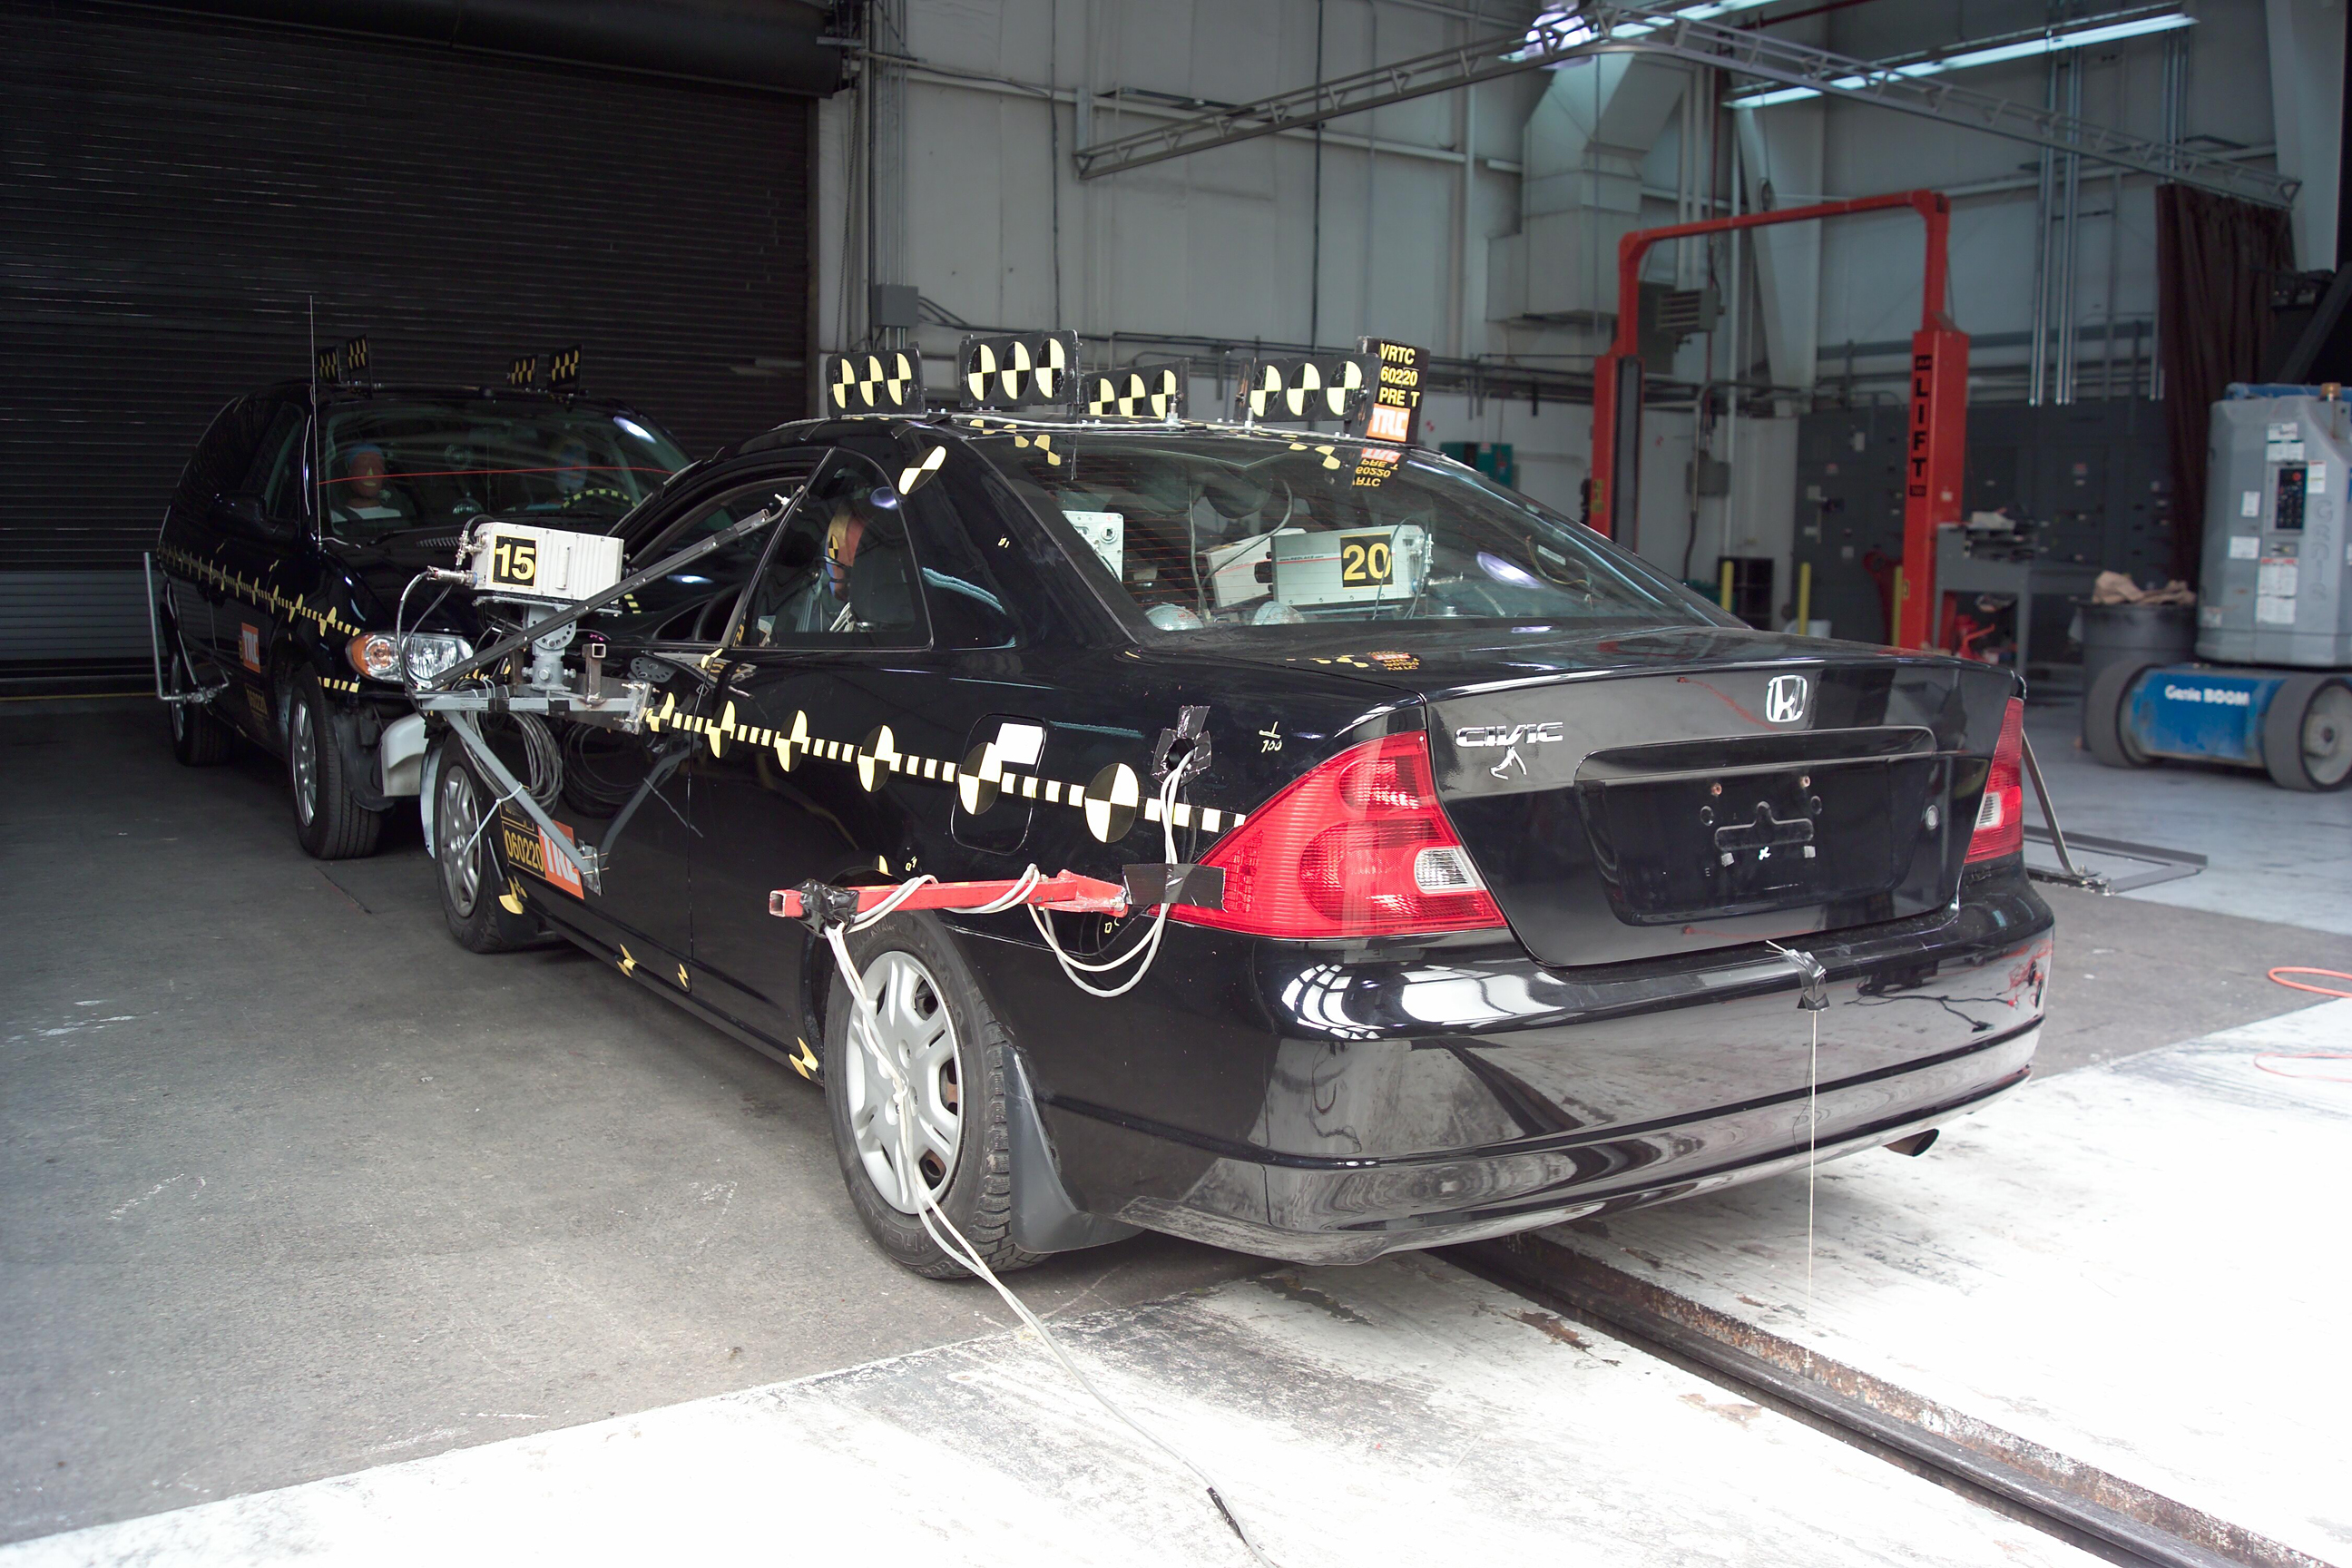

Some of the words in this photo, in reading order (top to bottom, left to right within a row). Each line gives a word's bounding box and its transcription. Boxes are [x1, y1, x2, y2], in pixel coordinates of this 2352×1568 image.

[1380, 343, 1416, 365] VRTC
[1380, 366, 1418, 387] 60220
[1378, 387, 1406, 407] PRE
[1410, 391, 1421, 407] T
[1372, 407, 1408, 436] TRC
[1912, 377, 1929, 477] LIFT
[495, 544, 536, 581] 15
[1343, 543, 1393, 581] 20
[2164, 684, 2202, 702] Genie
[2203, 688, 2250, 706] BOOM
[1455, 722, 1563, 747] CIVIC
[505, 829, 544, 872] 060220
